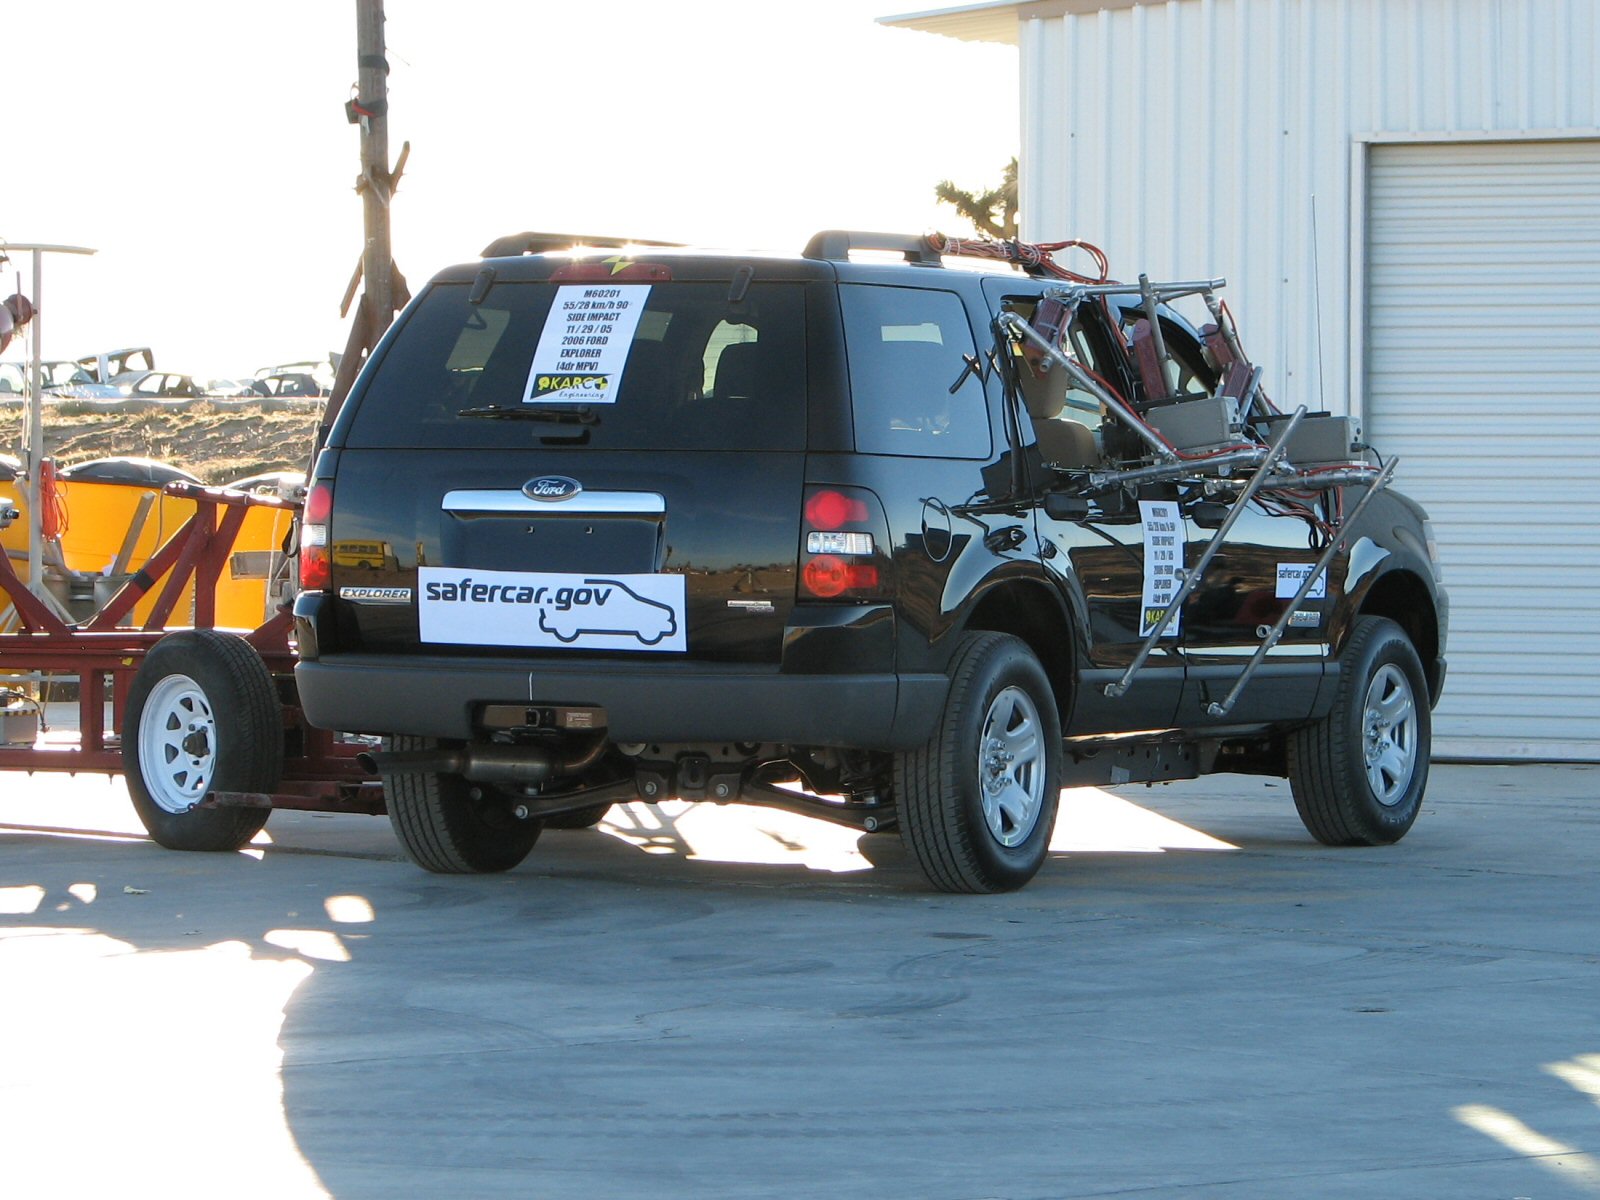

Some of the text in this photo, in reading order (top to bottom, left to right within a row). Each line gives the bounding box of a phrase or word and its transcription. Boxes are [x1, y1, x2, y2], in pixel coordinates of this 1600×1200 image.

[584, 290, 621, 298] M60201
[563, 301, 590, 310] 55/28
[591, 301, 614, 310] km/h
[567, 313, 621, 321] SIDE IMPACT
[562, 337, 609, 345] 2006 FORD
[560, 349, 602, 358] EXPLORER
[558, 391, 604, 399] Engineering
[533, 480, 566, 494] Ford
[342, 588, 409, 598] EXPLORER
[426, 578, 612, 610] safercar.gov
